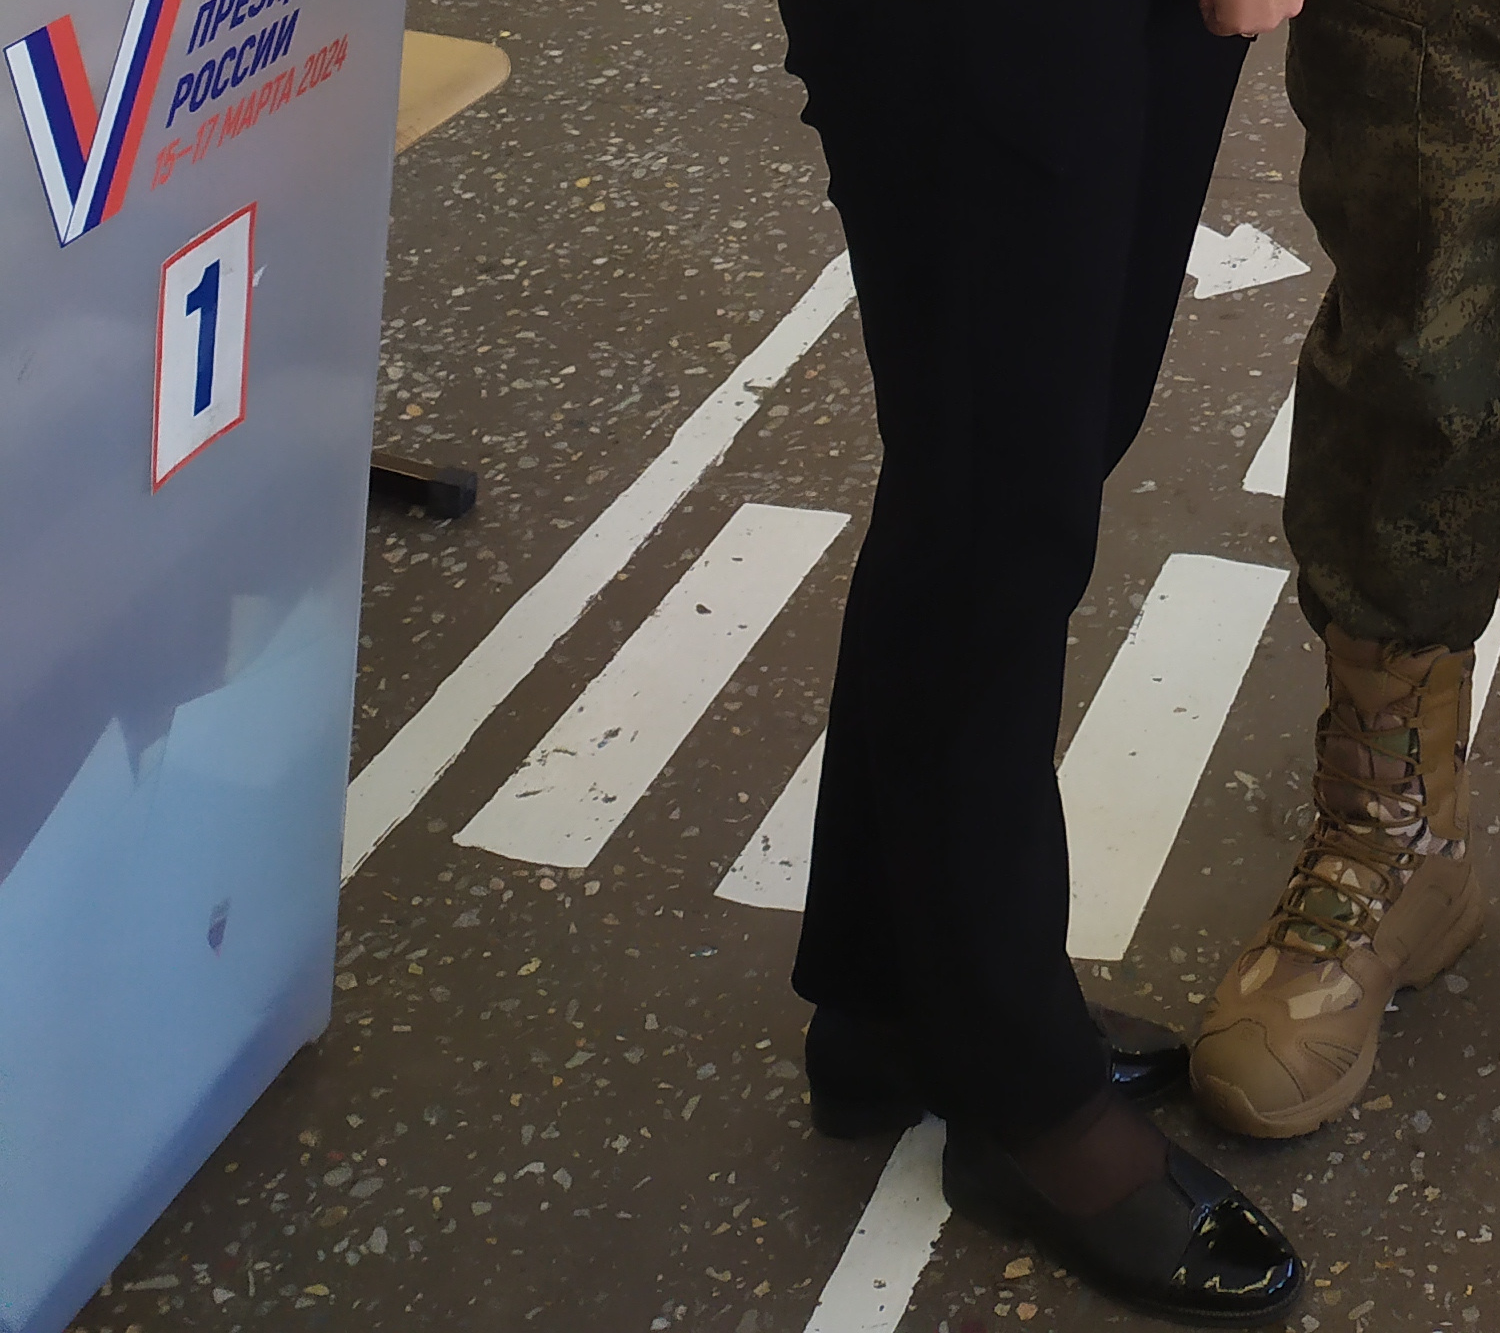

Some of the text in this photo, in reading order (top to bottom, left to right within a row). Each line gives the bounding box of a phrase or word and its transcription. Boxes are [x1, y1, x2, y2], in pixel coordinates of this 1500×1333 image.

[165, 8, 300, 129] РОССИИ
[217, 67, 296, 148] МАРТА
[295, 33, 349, 98] 2024
[185, 258, 222, 419] 1
